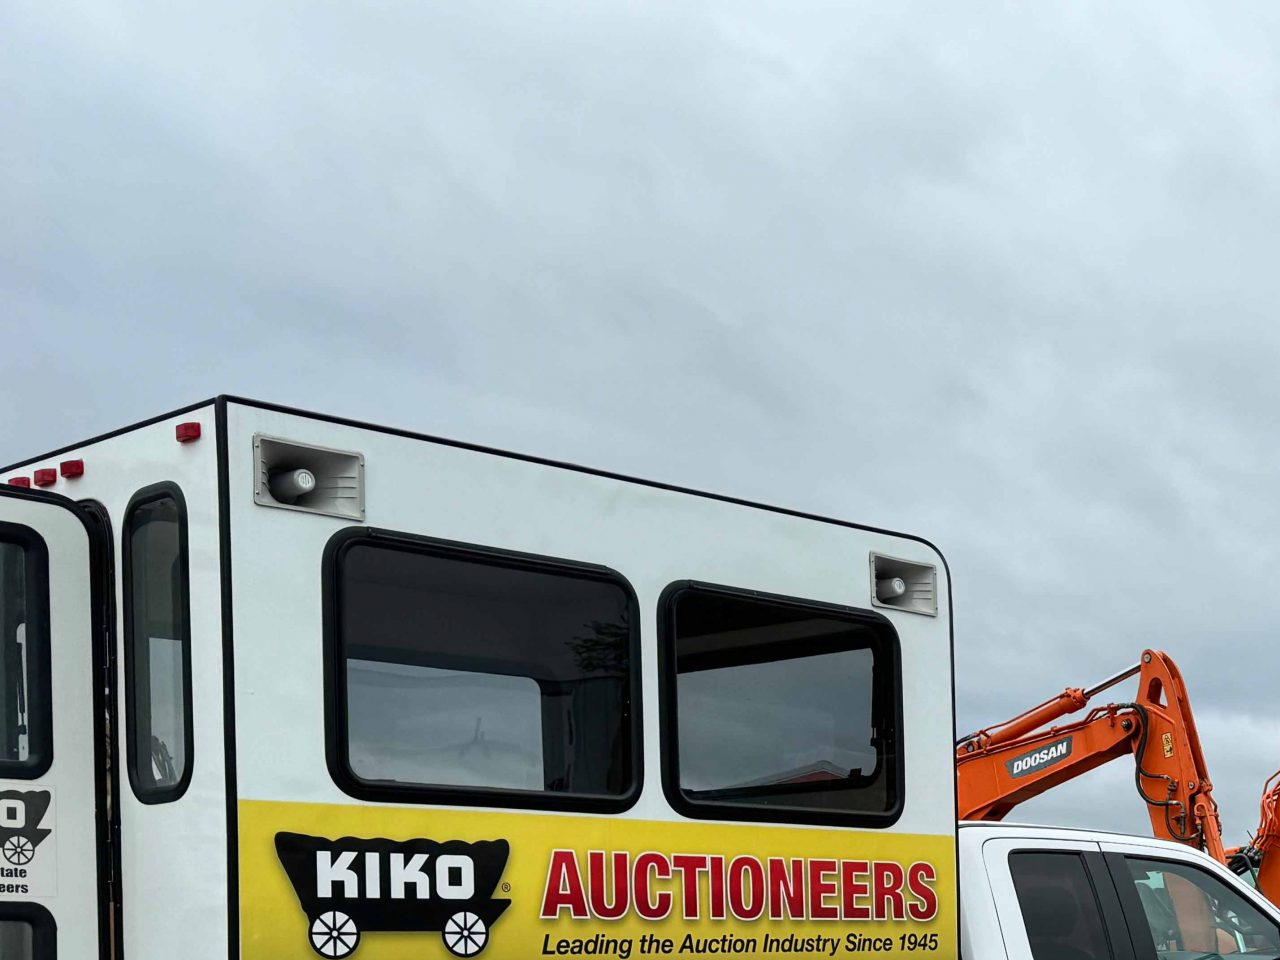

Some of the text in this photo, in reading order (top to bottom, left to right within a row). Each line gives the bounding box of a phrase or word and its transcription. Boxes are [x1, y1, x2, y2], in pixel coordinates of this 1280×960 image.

[1013, 741, 1067, 774] DOOSAN
[316, 850, 475, 900] KIKO
[539, 849, 939, 921] AUCTIONEERS
[542, 932, 939, 960] Leading the Auction Industry Since 1945
